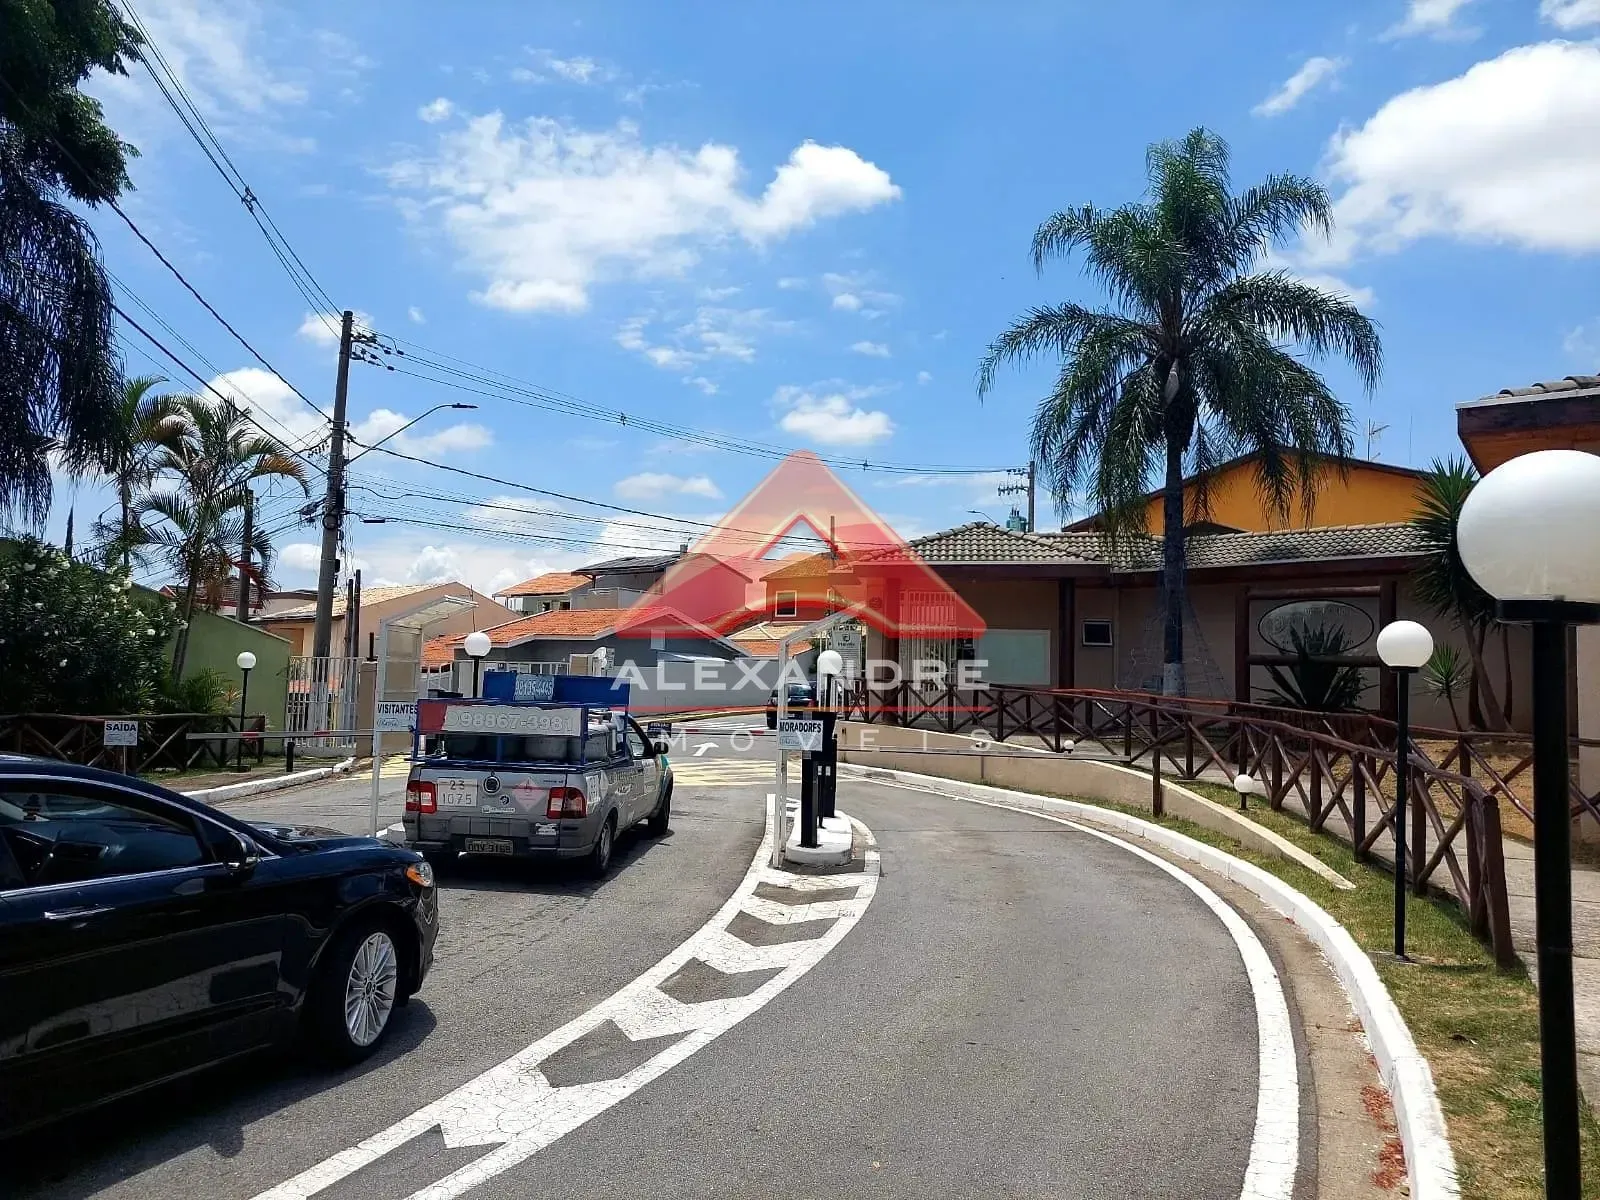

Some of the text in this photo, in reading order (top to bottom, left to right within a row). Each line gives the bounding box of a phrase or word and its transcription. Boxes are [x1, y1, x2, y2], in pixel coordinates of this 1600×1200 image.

[377, 703, 418, 714] VISITANTES
[779, 721, 822, 733] MORADORES
[449, 779, 465, 791] 23
[442, 792, 472, 805] 1075
